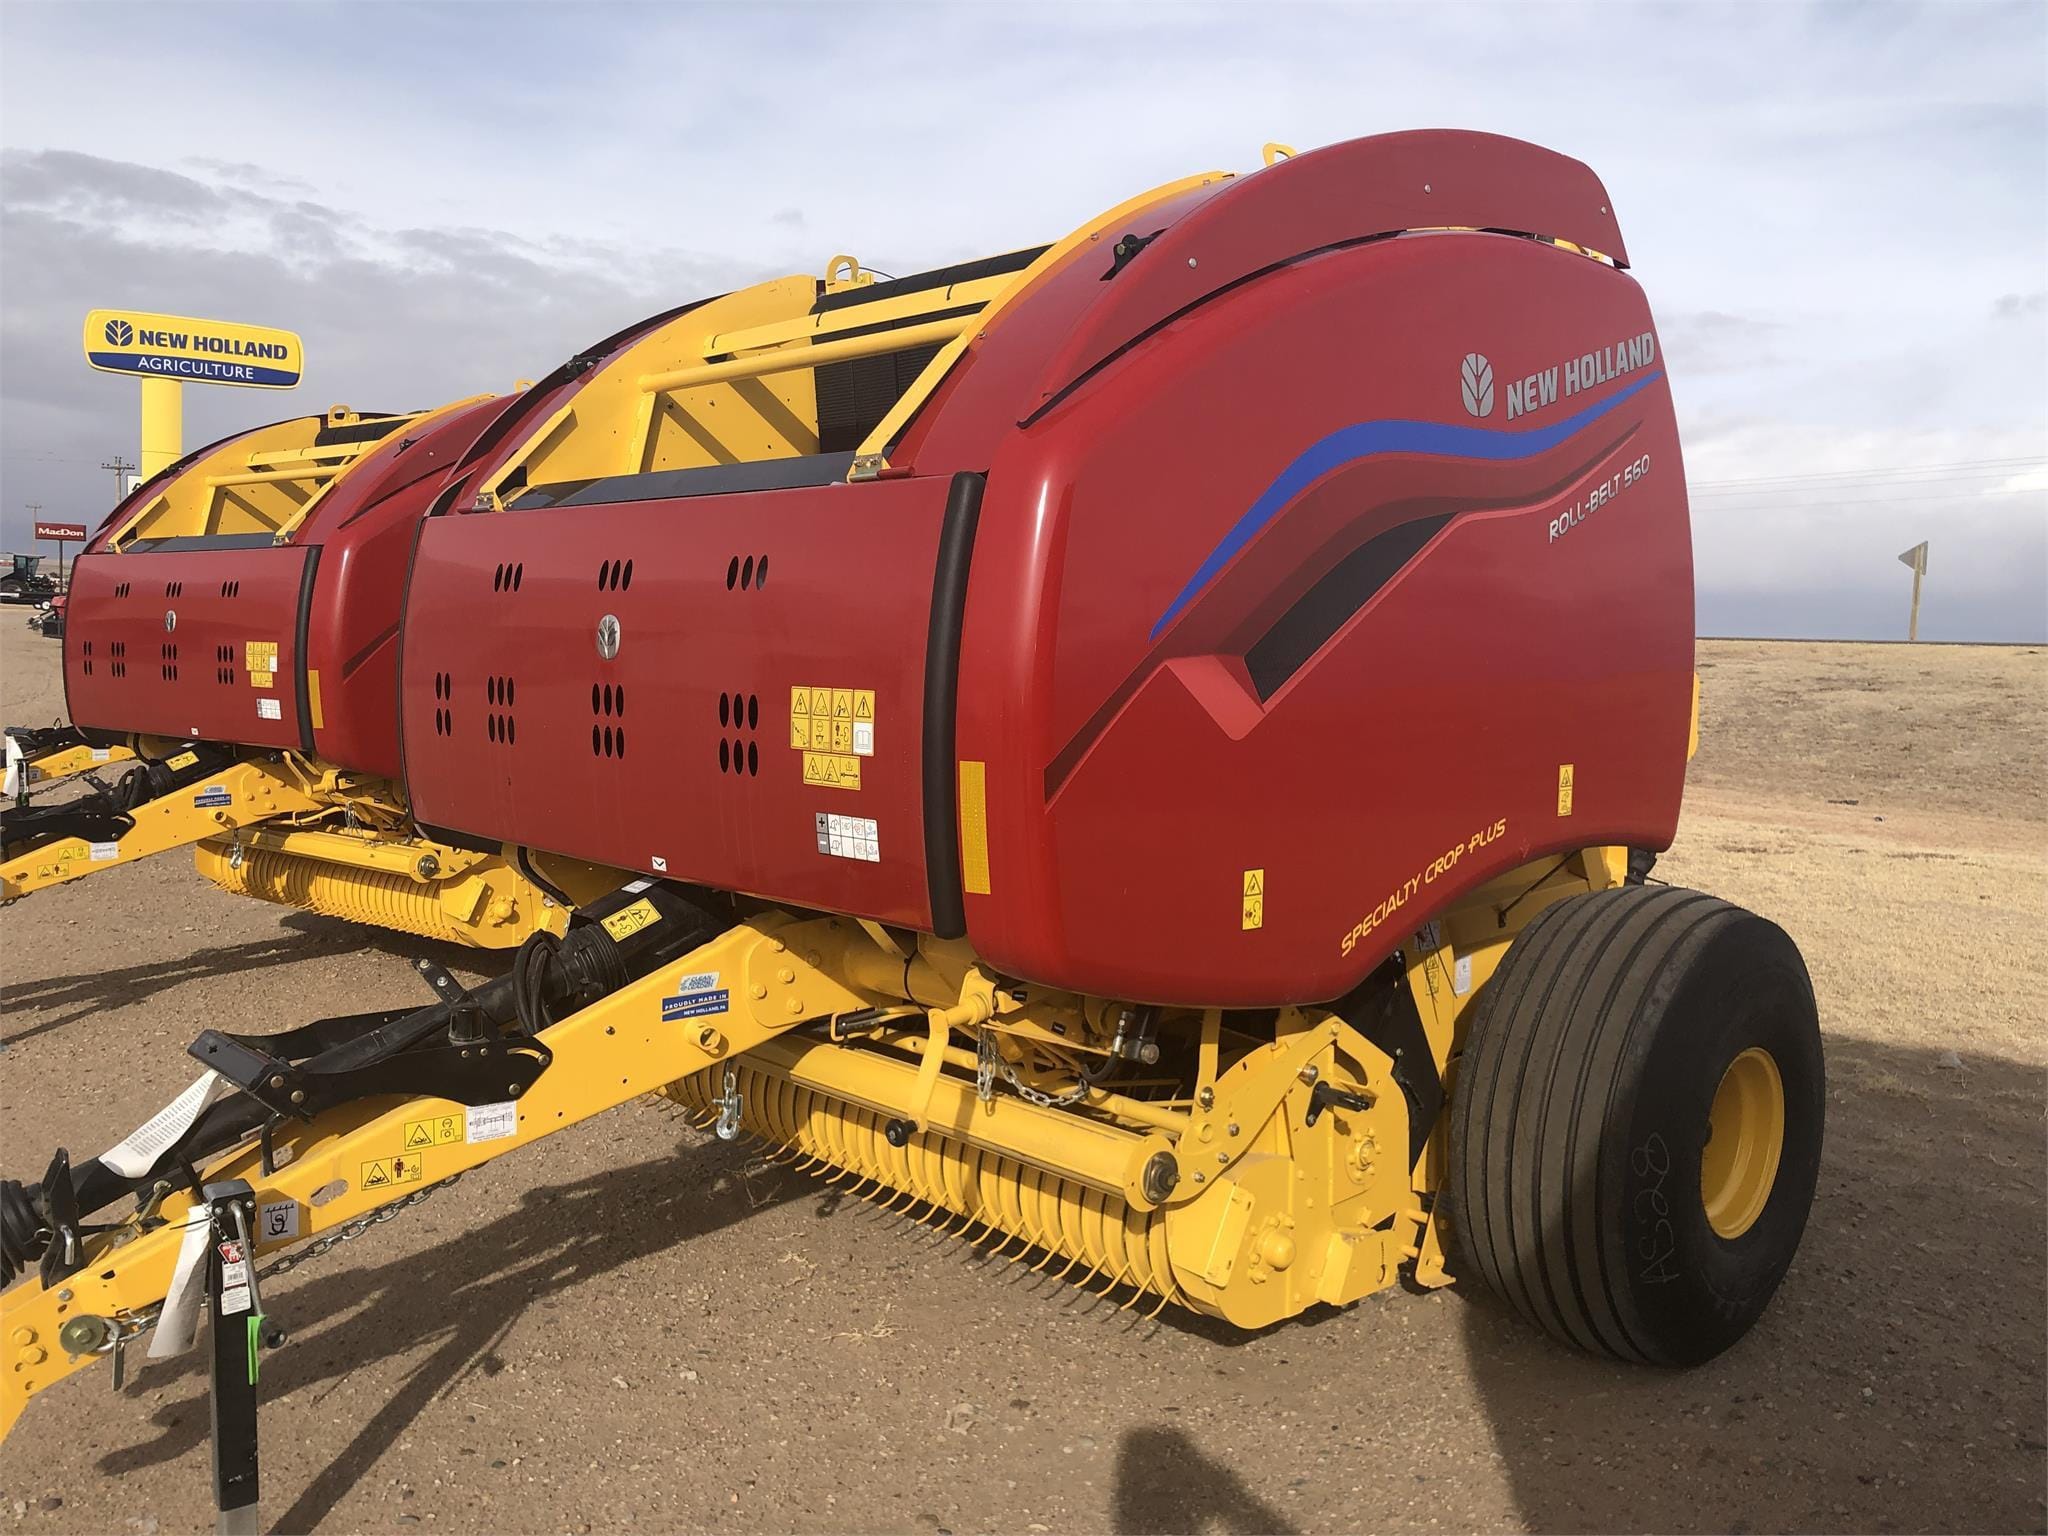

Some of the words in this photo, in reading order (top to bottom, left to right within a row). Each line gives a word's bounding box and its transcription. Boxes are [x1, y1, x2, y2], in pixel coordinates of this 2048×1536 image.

[139, 329, 188, 349] NEW
[193, 335, 288, 360] HOLLAND
[137, 356, 254, 379] AGRICULTURE
[1507, 366, 1559, 421] NEW
[1564, 331, 1655, 397] HOLLAND
[1549, 473, 1621, 544] ROLL-BELT
[1624, 454, 1650, 489] 560
[38, 527, 84, 537] MacDon
[1341, 873, 1422, 958] SPECIALTY
[1424, 843, 1465, 884] CROP
[1467, 818, 1507, 854] PLUS
[664, 999, 697, 1010] PROUDLY
[698, 995, 717, 1003] MADE
